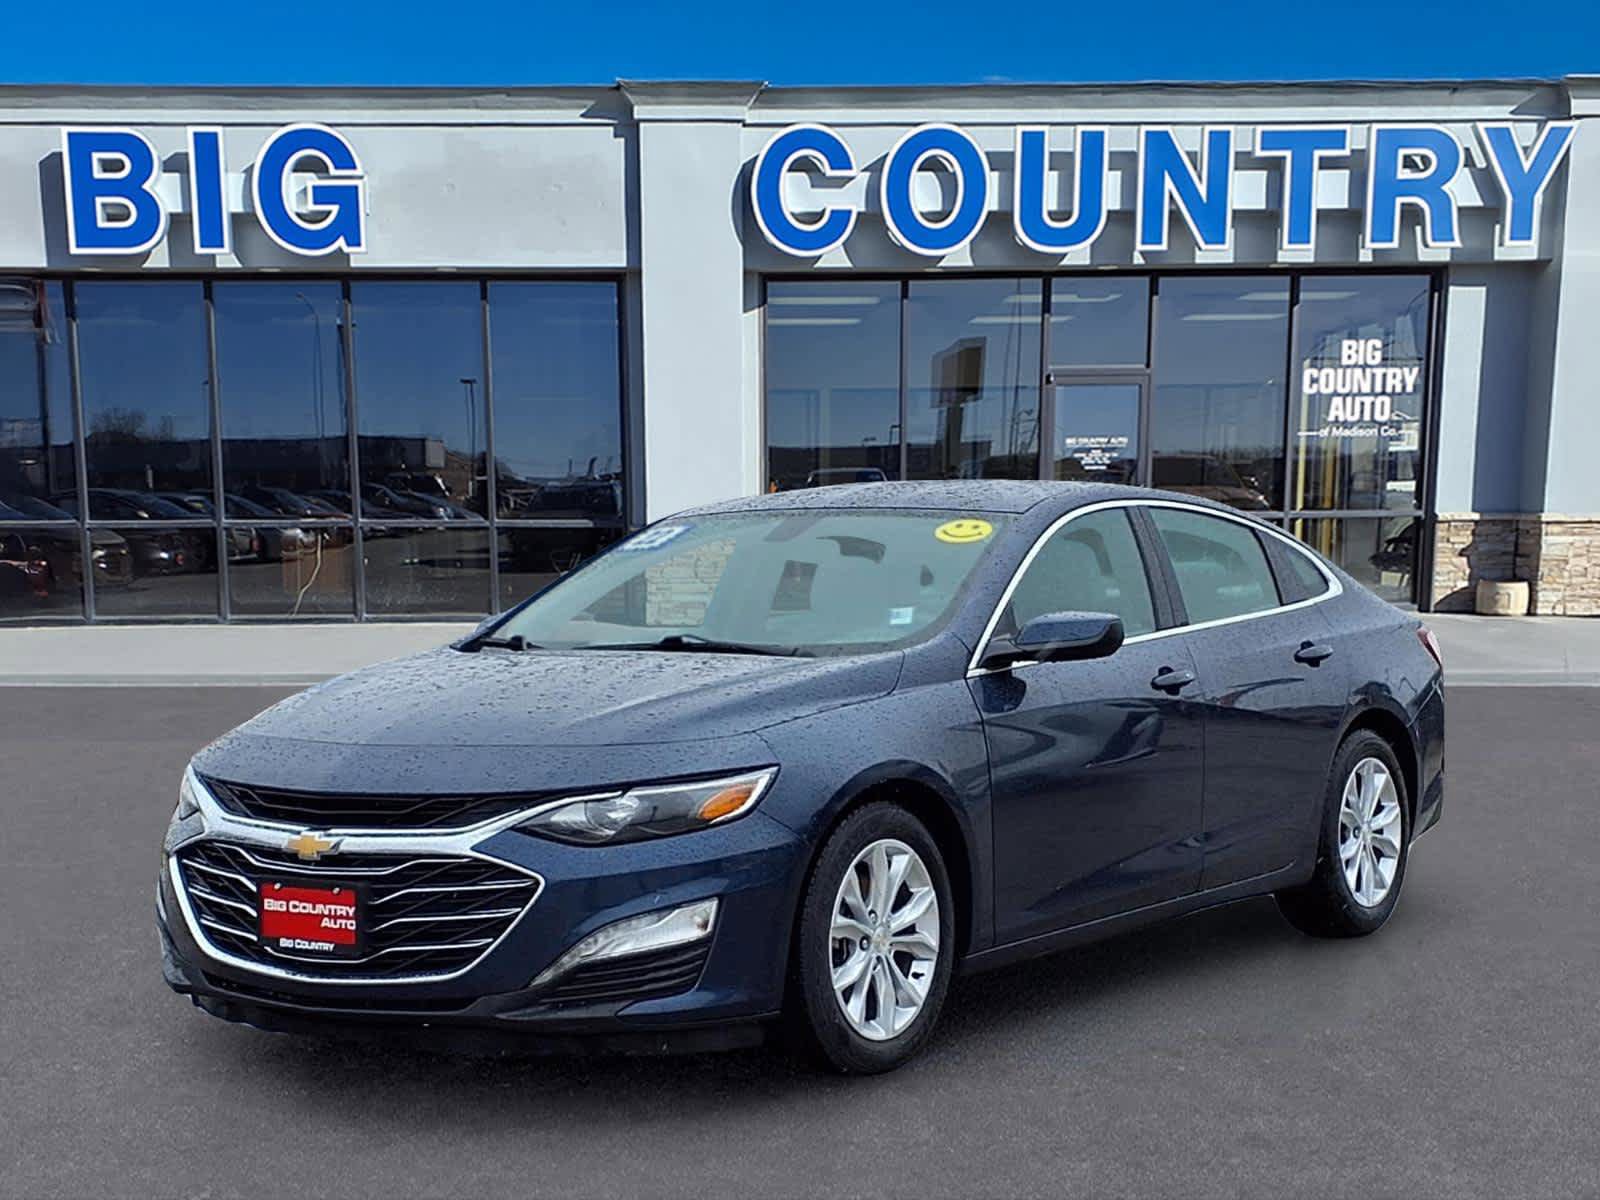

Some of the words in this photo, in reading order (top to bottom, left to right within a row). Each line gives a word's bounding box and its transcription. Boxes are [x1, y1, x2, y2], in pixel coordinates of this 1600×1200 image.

[61, 123, 367, 255] BIG
[750, 121, 1574, 256] COUNTRY
[1341, 339, 1383, 366] BIG
[1303, 367, 1420, 394] COUNTRY
[1328, 396, 1392, 422] AUTO
[1319, 425, 1330, 437] of
[1332, 426, 1378, 437] Madison
[263, 899, 287, 912] BIG
[288, 900, 356, 917] COUNTRY
[320, 917, 356, 930] AUTO
[295, 940, 335, 952] COUNTRY
